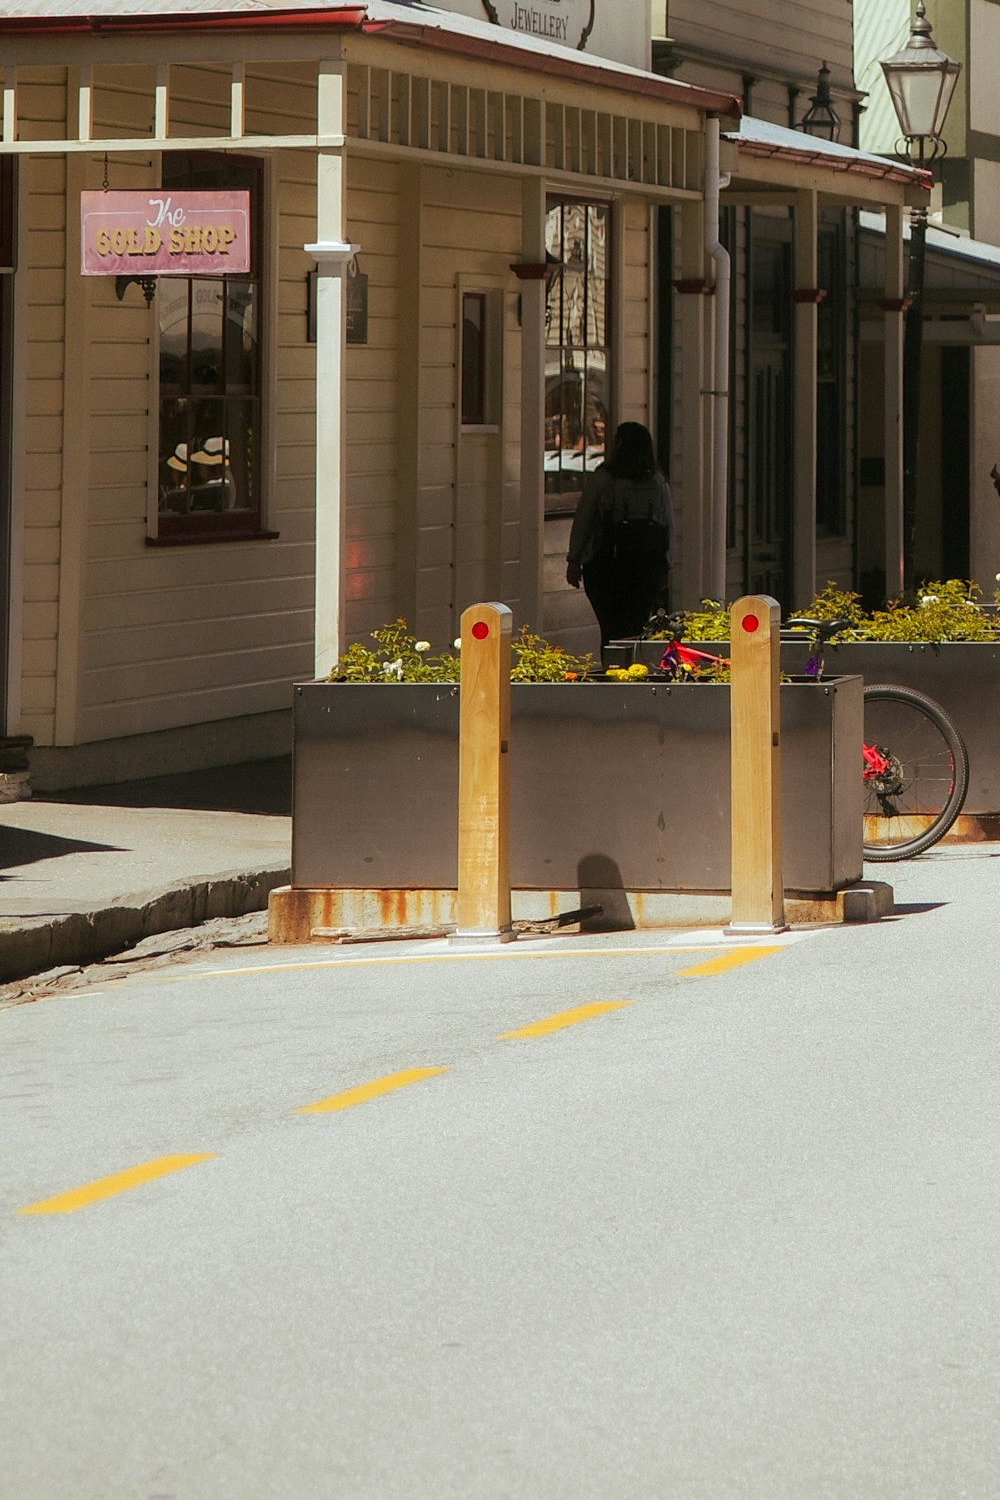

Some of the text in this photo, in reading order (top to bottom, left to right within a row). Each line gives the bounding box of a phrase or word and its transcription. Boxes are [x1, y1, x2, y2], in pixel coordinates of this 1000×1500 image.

[510, 1, 569, 41] JEWELLERY
[146, 197, 186, 228] The
[95, 225, 238, 258] GOLD SHOP
